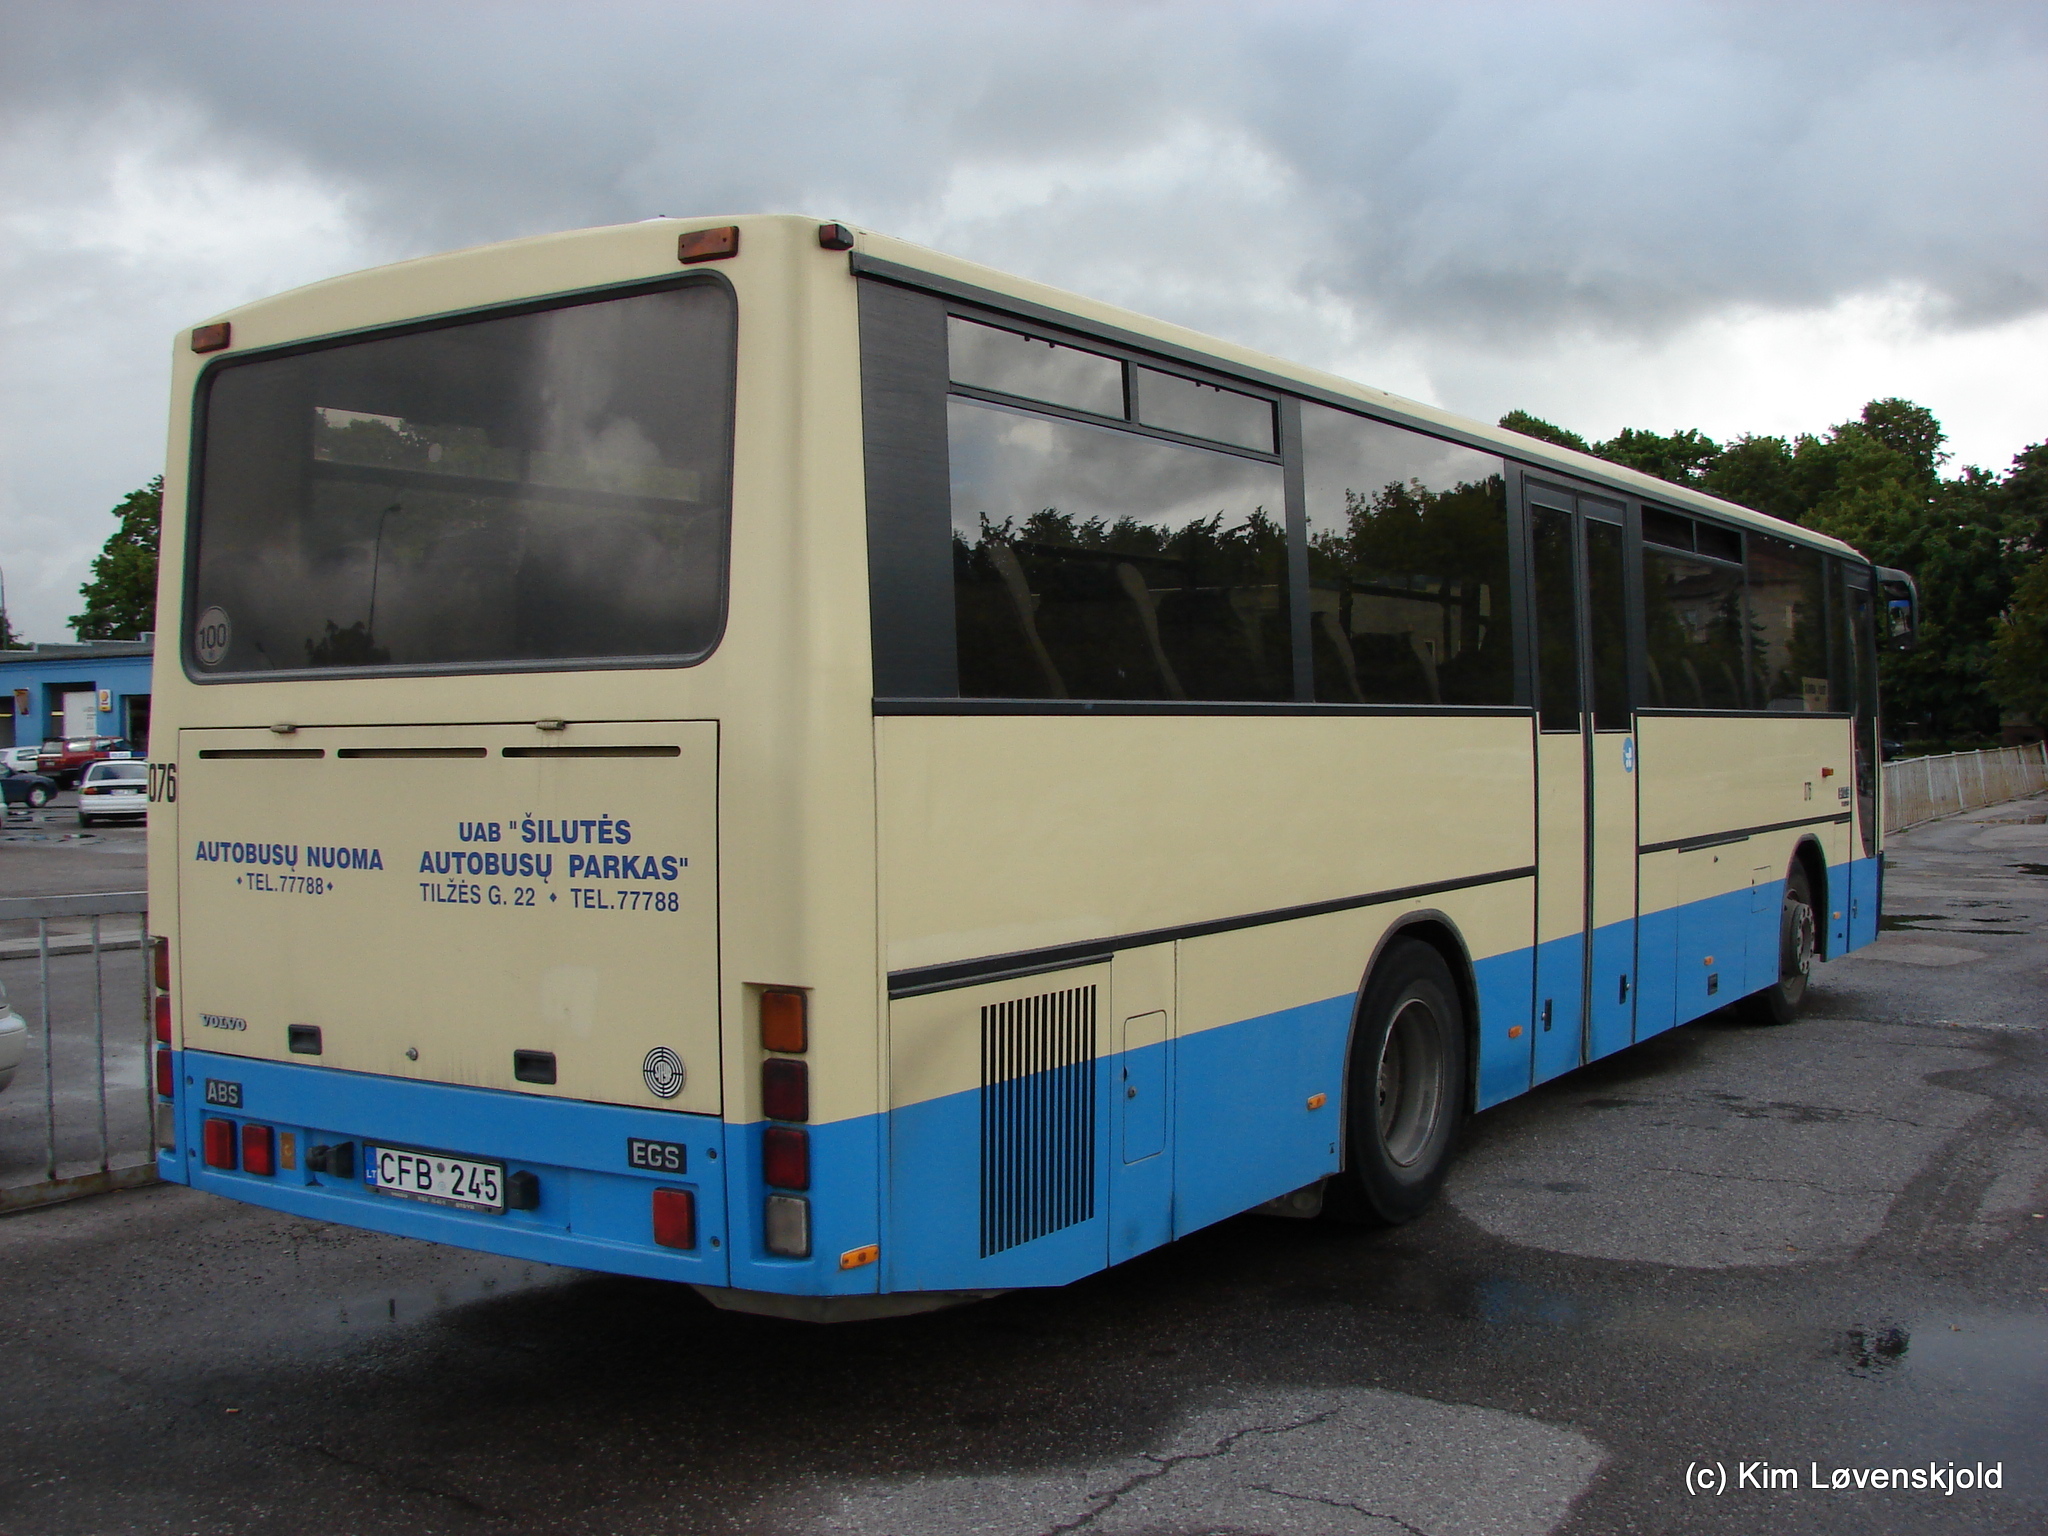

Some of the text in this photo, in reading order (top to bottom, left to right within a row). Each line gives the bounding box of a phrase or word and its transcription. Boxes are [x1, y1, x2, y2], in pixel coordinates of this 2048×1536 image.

[200, 623, 226, 649] 100
[149, 763, 176, 802] 076
[459, 812, 631, 845] UAB "ŠILUTĖS
[196, 841, 384, 872] AUTOBUSŲ NUOMA
[419, 851, 688, 884] AUTOBUSŲ PARKAS"
[246, 872, 324, 895] TEL.77788
[419, 877, 680, 912] TILŽĖS G. 22 TEL.77788
[199, 1013, 247, 1031] VOLVO
[207, 1081, 239, 1104] ABS
[632, 1141, 679, 1169] EGS
[366, 1169, 377, 1179] LT
[381, 1152, 433, 1190] CFB
[451, 1164, 497, 1201] 245
